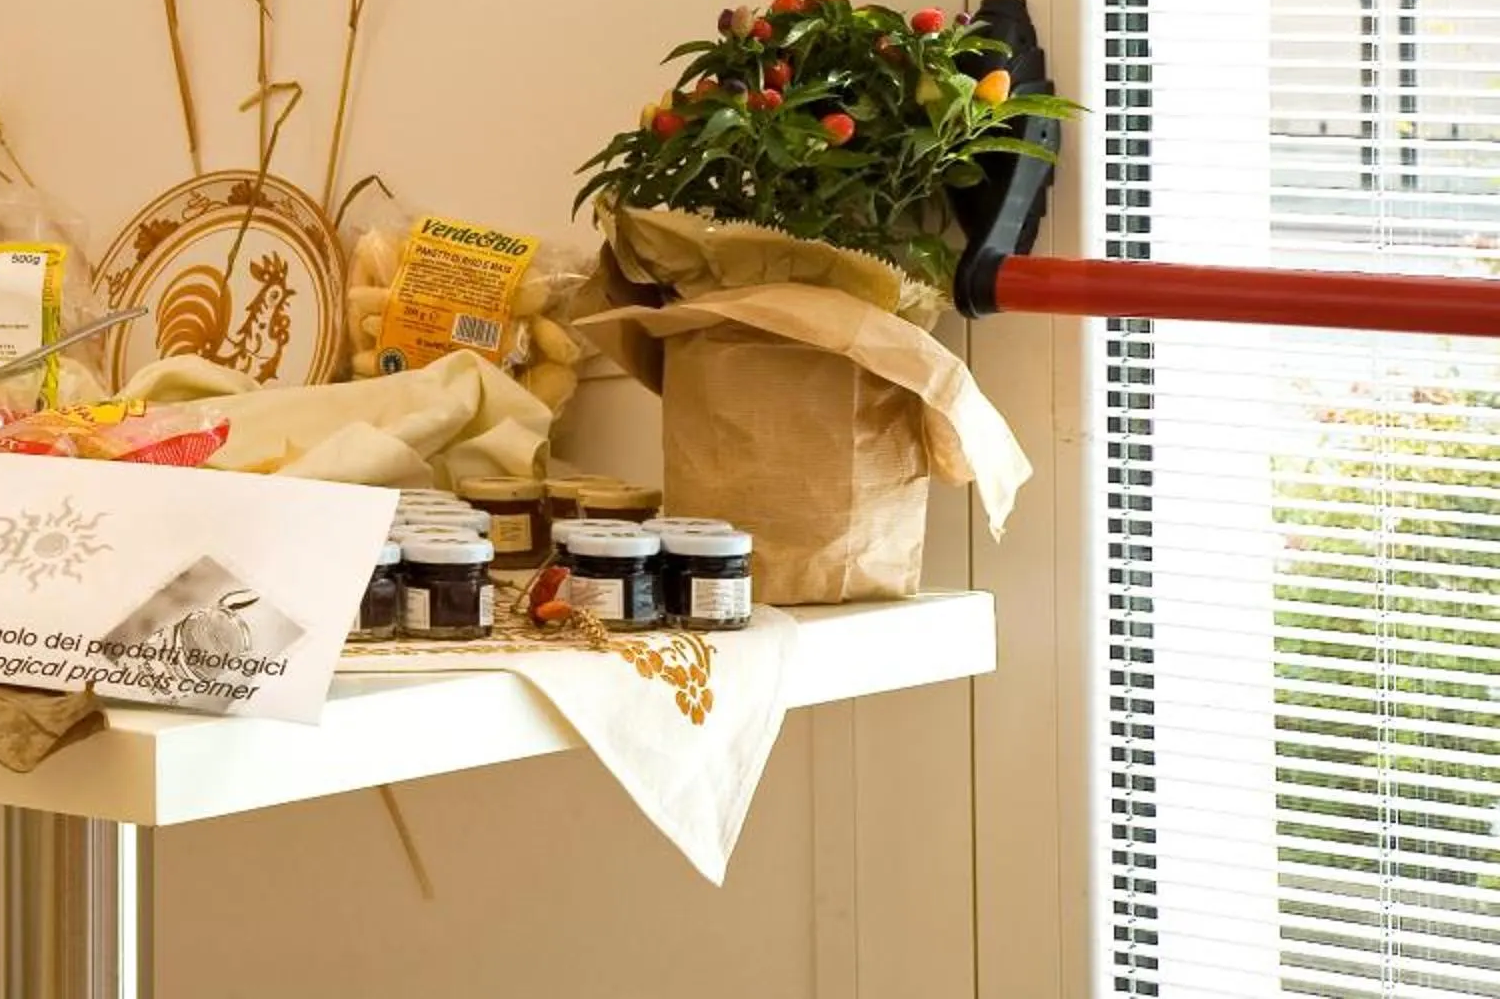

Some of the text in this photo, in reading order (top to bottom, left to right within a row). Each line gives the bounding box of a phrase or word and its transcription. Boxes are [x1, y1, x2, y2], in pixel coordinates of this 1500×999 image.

[11, 253, 41, 265] 500g
[44, 633, 81, 653] dei
[86, 638, 180, 666] prodotti
[186, 650, 289, 678] Biologici
[65, 662, 174, 693] products
[177, 677, 261, 702] corner
